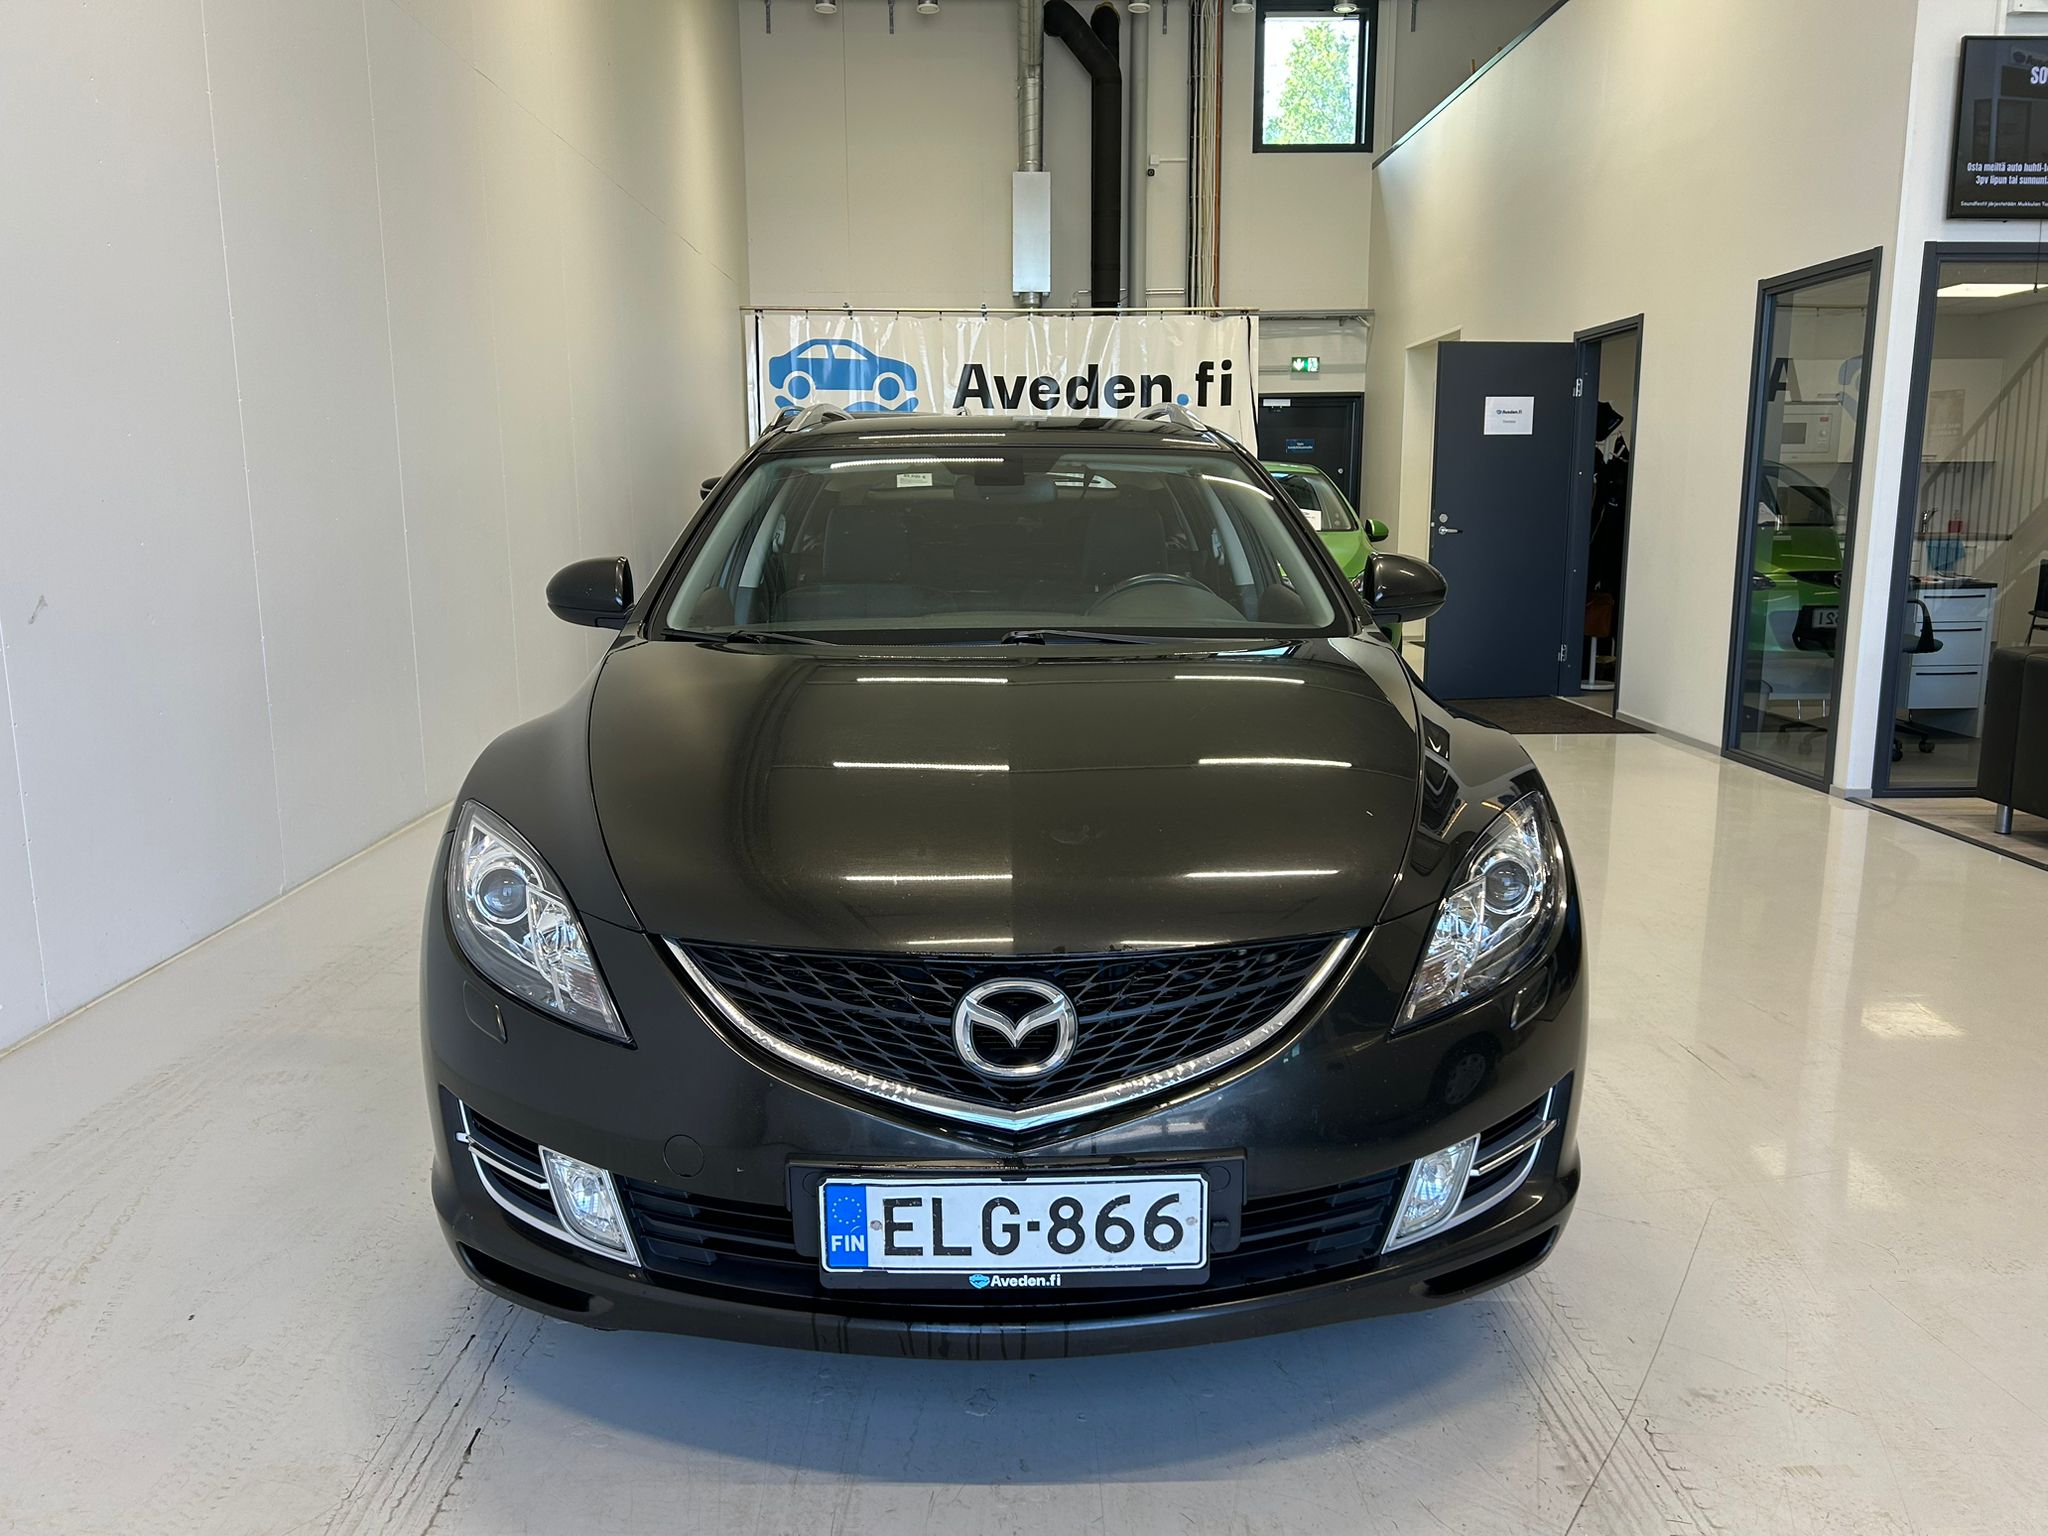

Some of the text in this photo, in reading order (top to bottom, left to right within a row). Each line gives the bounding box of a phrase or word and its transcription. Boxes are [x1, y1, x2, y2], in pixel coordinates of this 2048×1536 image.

[1967, 163, 1983, 172] Osta
[1984, 162, 2006, 172] meiltä
[2007, 163, 2023, 172] auto
[2008, 175, 2018, 184] tai
[953, 358, 1233, 410] Aveden.fi
[882, 1193, 1184, 1256] ELG-866
[831, 1235, 866, 1253] FIN
[990, 1273, 1062, 1288] Aveden.fi
